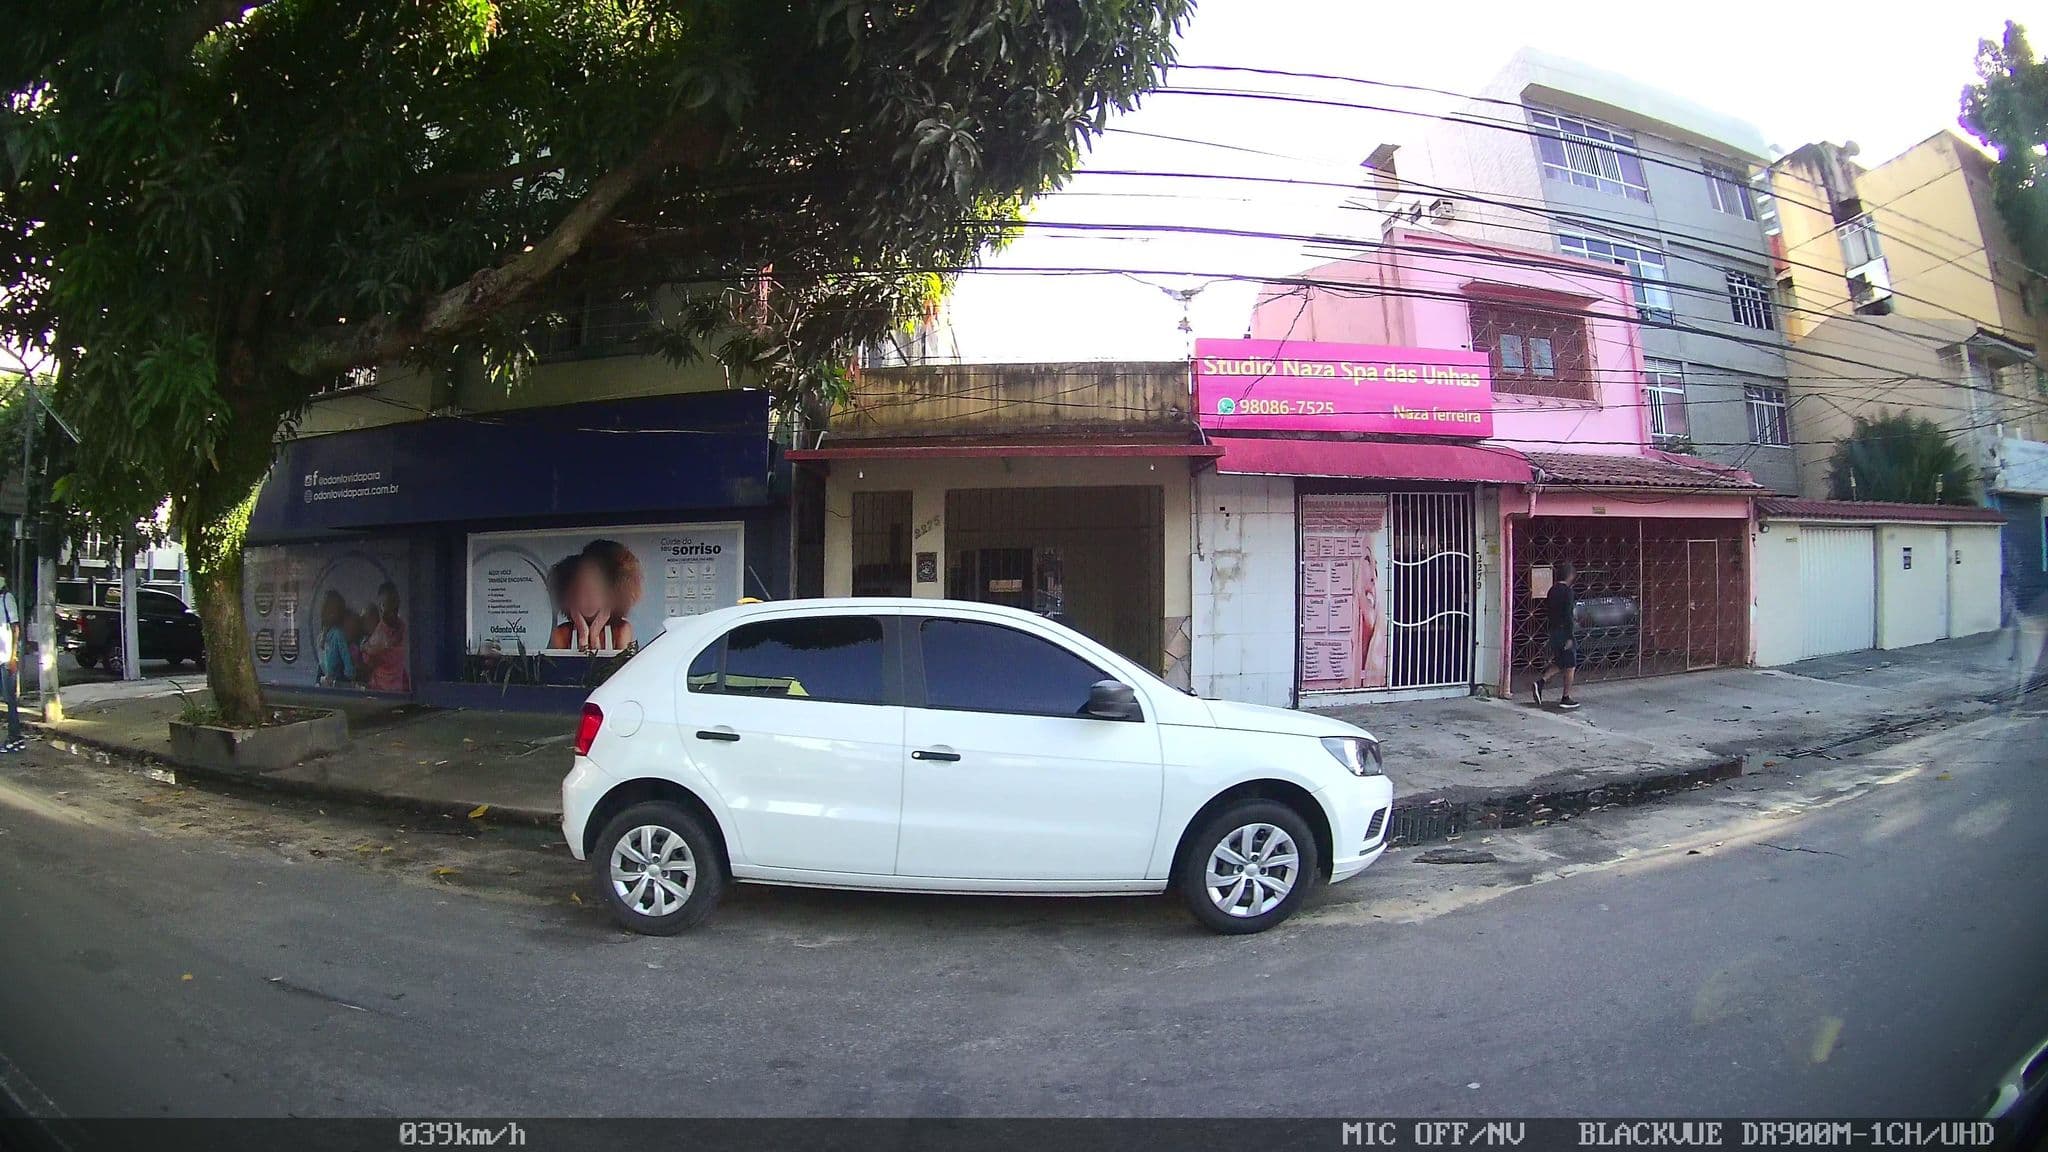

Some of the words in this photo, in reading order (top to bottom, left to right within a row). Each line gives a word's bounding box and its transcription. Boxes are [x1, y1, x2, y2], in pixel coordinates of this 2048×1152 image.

[1203, 355, 1277, 377] Studio
[1282, 359, 1336, 379] Naza
[1341, 361, 1379, 387] Spa
[1383, 362, 1418, 384] das
[1422, 365, 1481, 388] Unhas
[1239, 399, 1335, 416] 98086-7525
[1393, 403, 1430, 421] Naza
[671, 542, 722, 556] sorriso
